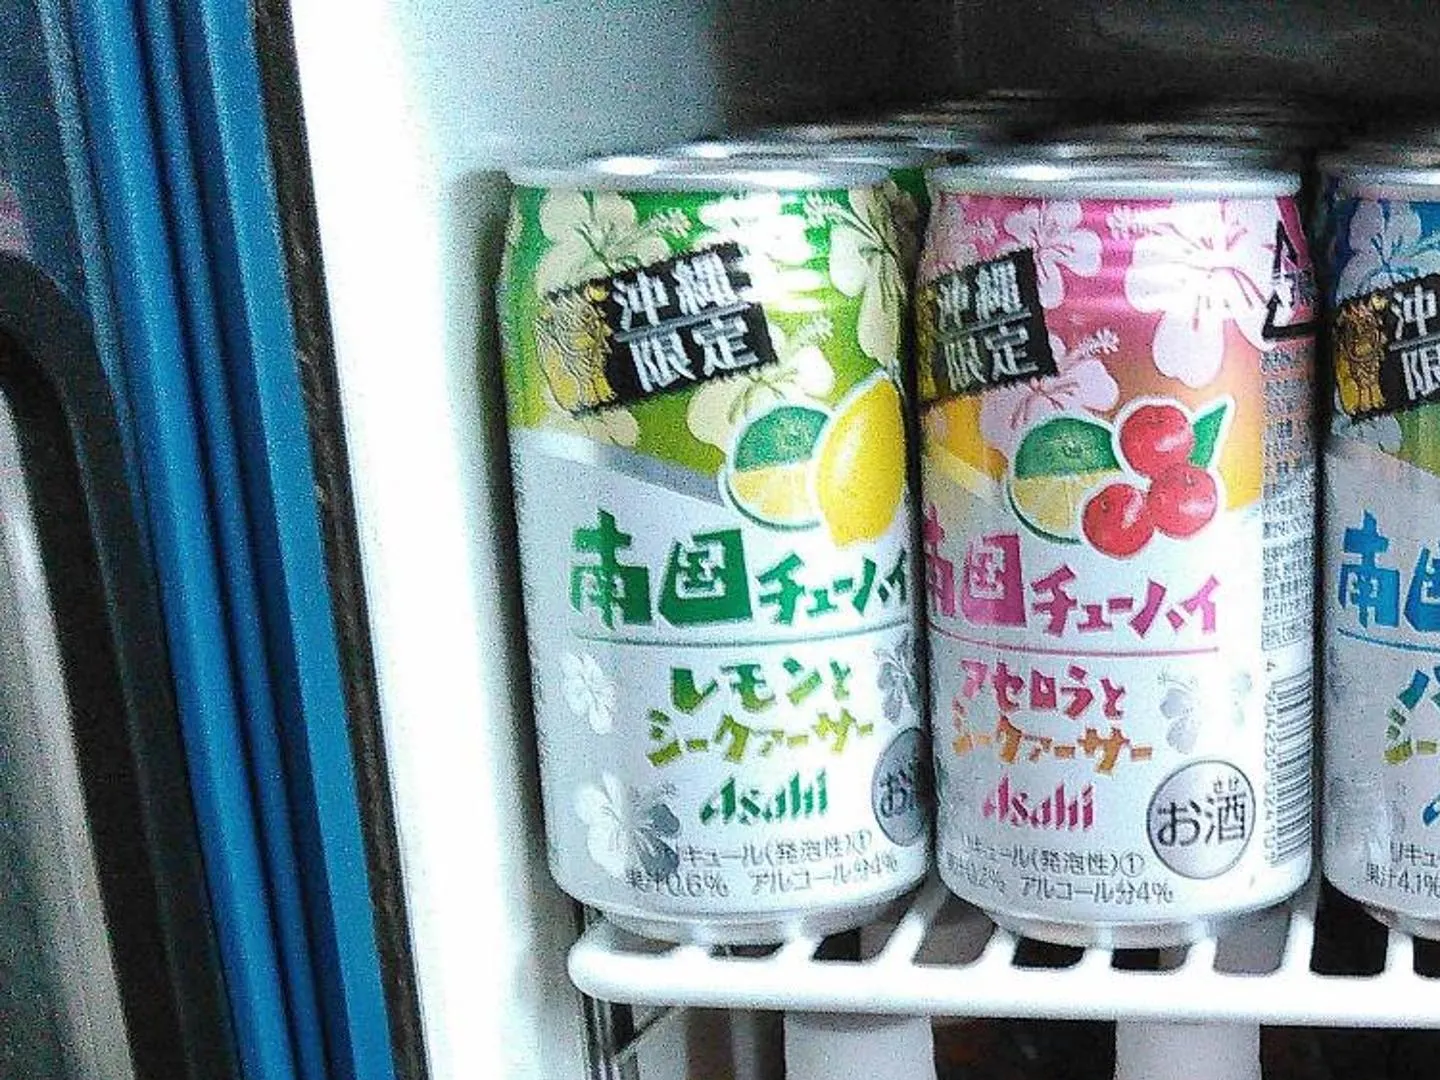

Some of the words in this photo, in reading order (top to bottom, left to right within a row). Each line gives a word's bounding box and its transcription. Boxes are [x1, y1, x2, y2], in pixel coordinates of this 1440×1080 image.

[629, 312, 759, 392] 限定
[944, 325, 1040, 392] 限定
[670, 657, 852, 715] レモンと
[960, 658, 1127, 720] アセロラと
[701, 768, 829, 826] Asahi
[982, 774, 1096, 832] Asahi
[1156, 792, 1247, 849] お酒
